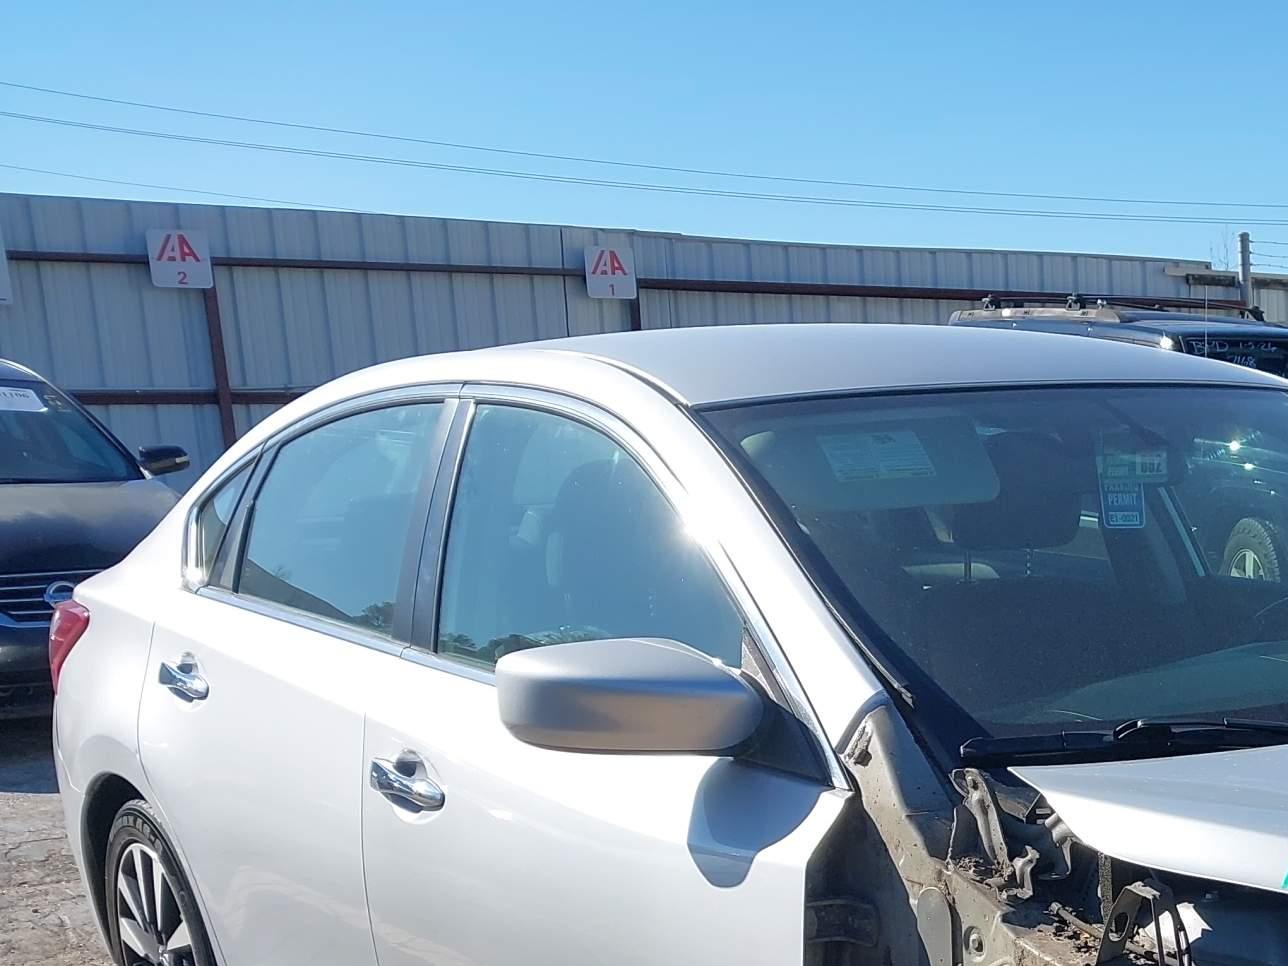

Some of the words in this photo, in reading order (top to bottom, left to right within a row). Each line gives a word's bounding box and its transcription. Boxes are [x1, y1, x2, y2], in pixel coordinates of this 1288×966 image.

[177, 271, 188, 285] 2
[608, 284, 615, 297] 1
[1107, 493, 1138, 505] PERMIT
